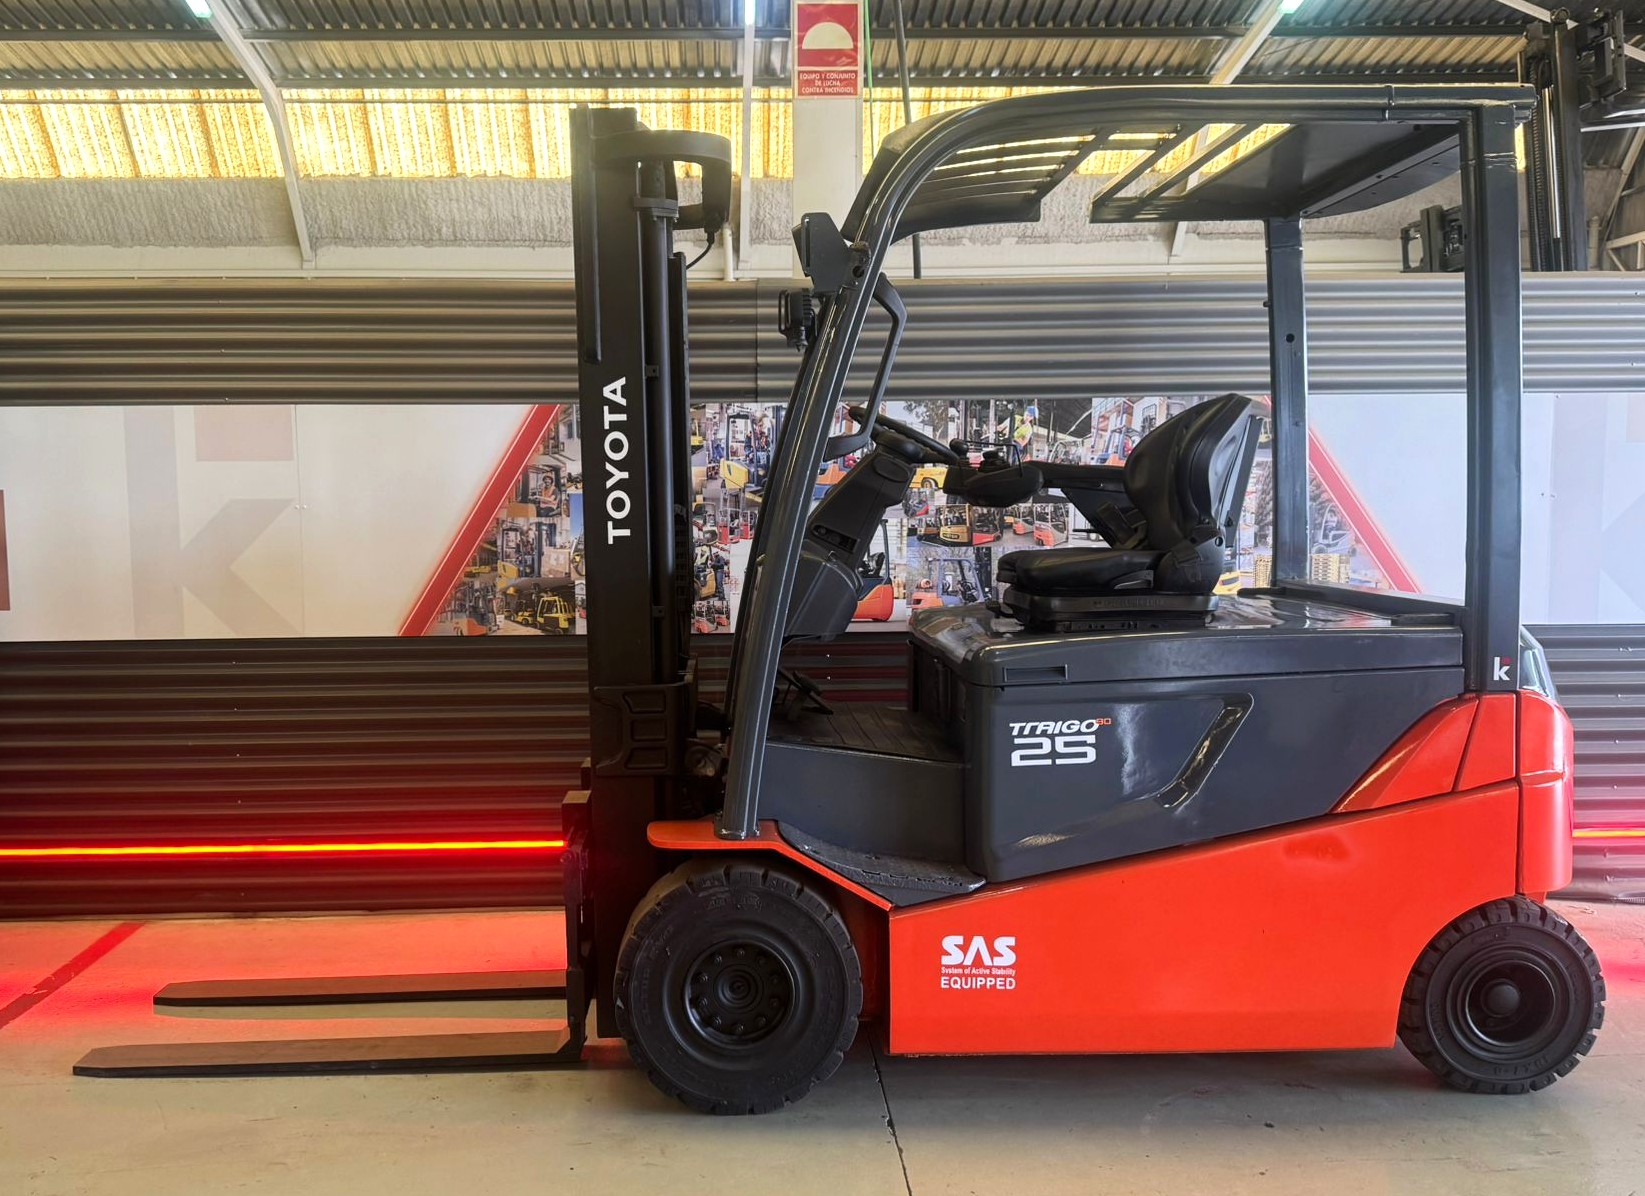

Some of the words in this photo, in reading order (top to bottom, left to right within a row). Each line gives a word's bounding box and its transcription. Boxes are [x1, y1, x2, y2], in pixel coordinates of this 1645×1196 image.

[603, 376, 631, 545] TOYOTA
[1011, 735, 1097, 767] 25
[941, 935, 1016, 966] SAS
[941, 967, 963, 975] System
[971, 967, 990, 975] Active
[991, 967, 1016, 977] Stability
[941, 976, 1016, 990] EQUIPPED
